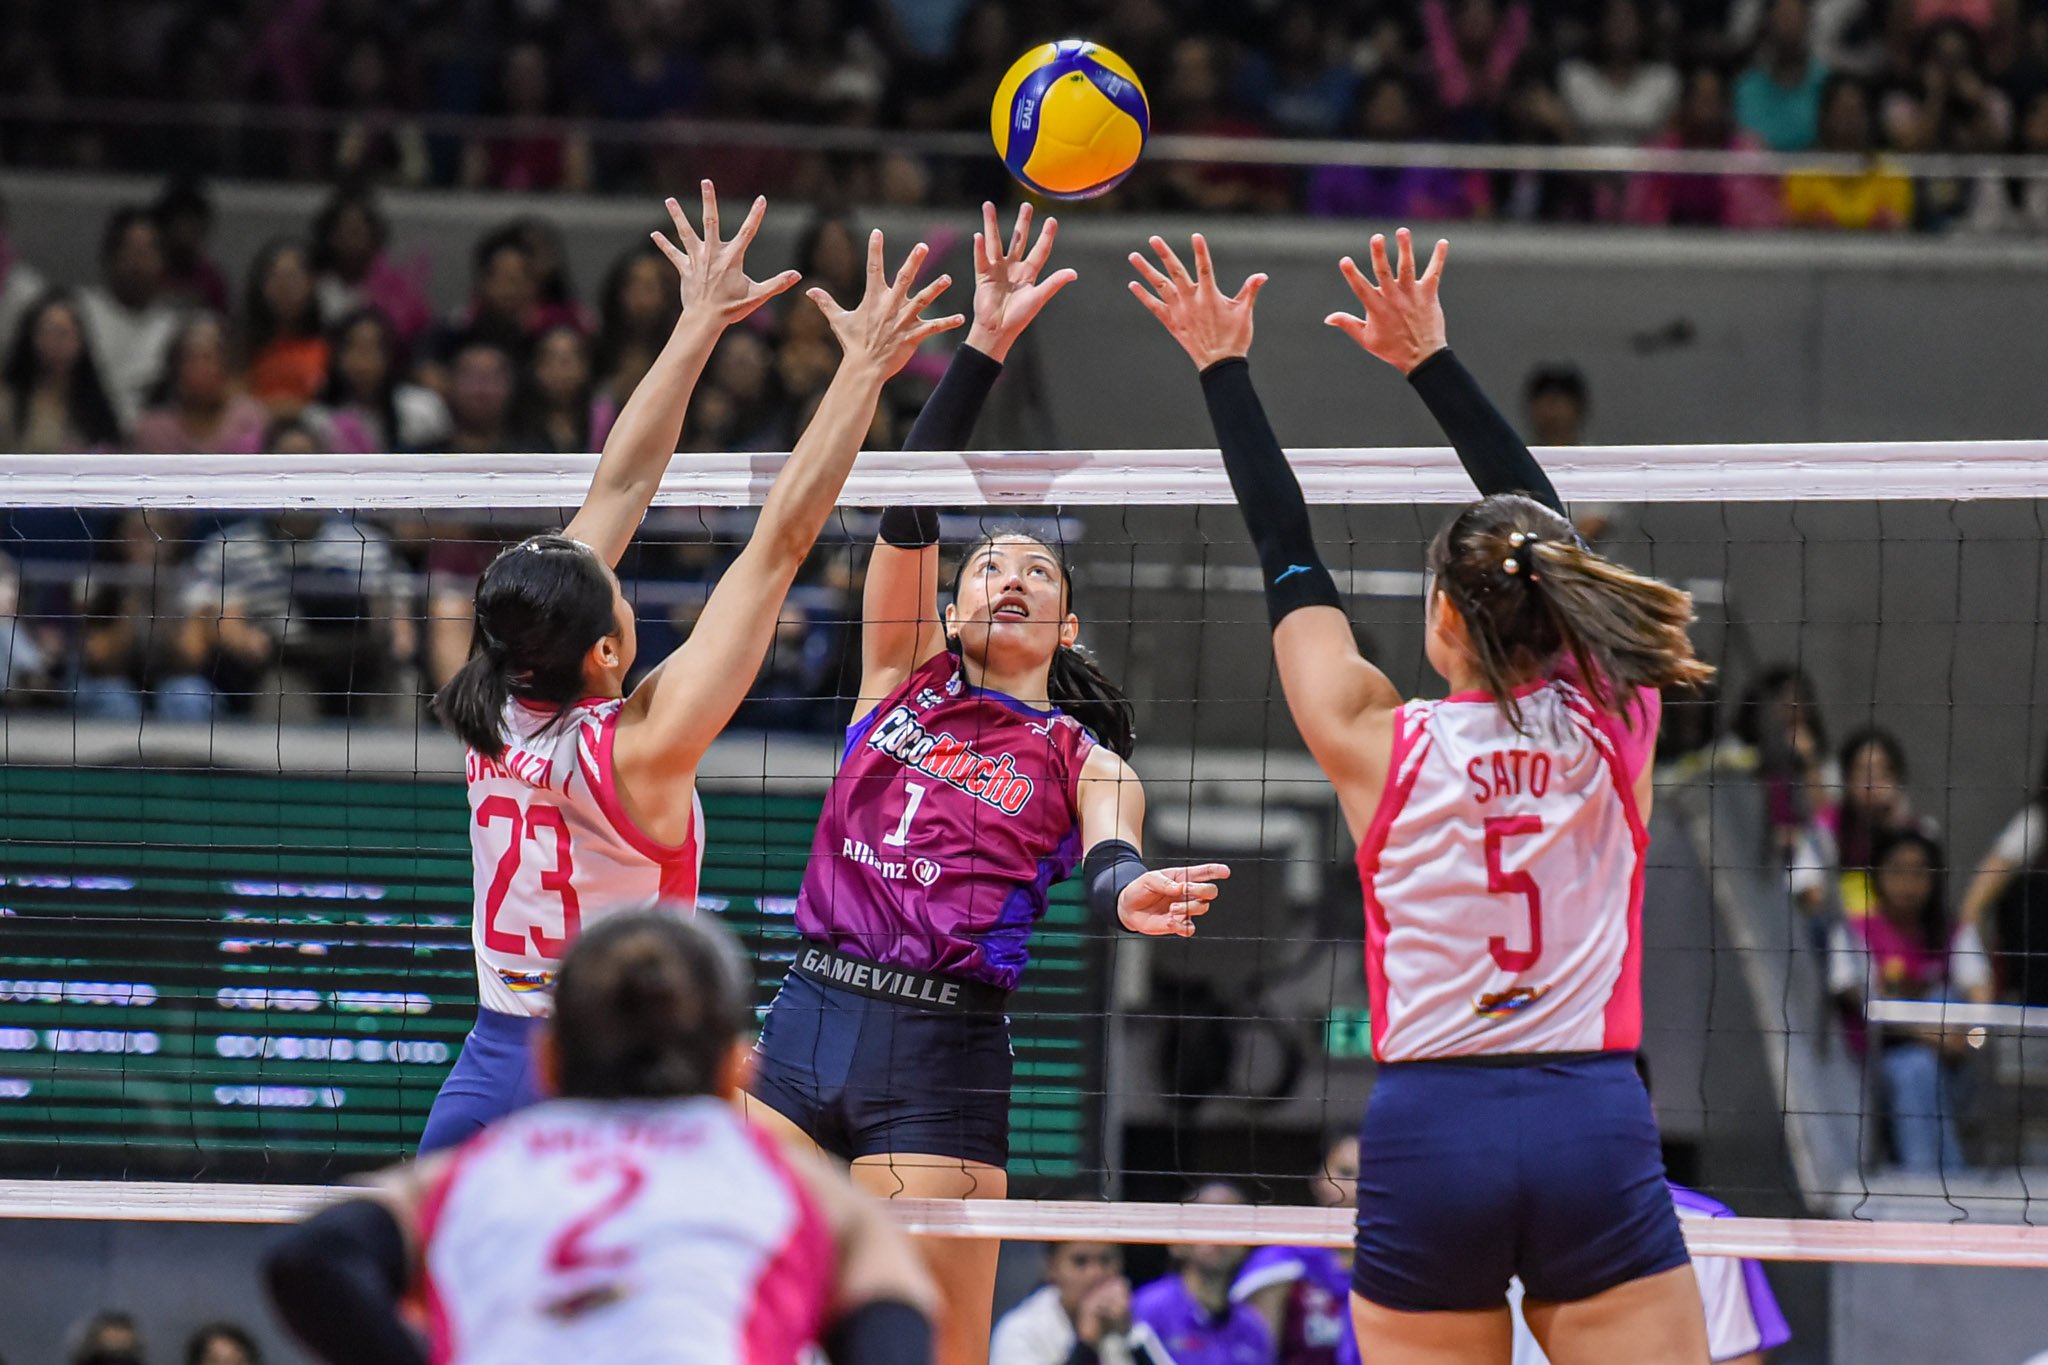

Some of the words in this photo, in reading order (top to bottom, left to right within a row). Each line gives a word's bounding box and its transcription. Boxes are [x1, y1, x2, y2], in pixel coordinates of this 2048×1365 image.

[1467, 750, 1551, 804] SATO
[883, 782, 926, 847] 1
[476, 795, 581, 960] 23
[842, 837, 908, 880] Allianz
[1484, 815, 1543, 973] 5
[801, 949, 960, 1006] GAMEVILLE
[549, 1156, 648, 1274] 2
